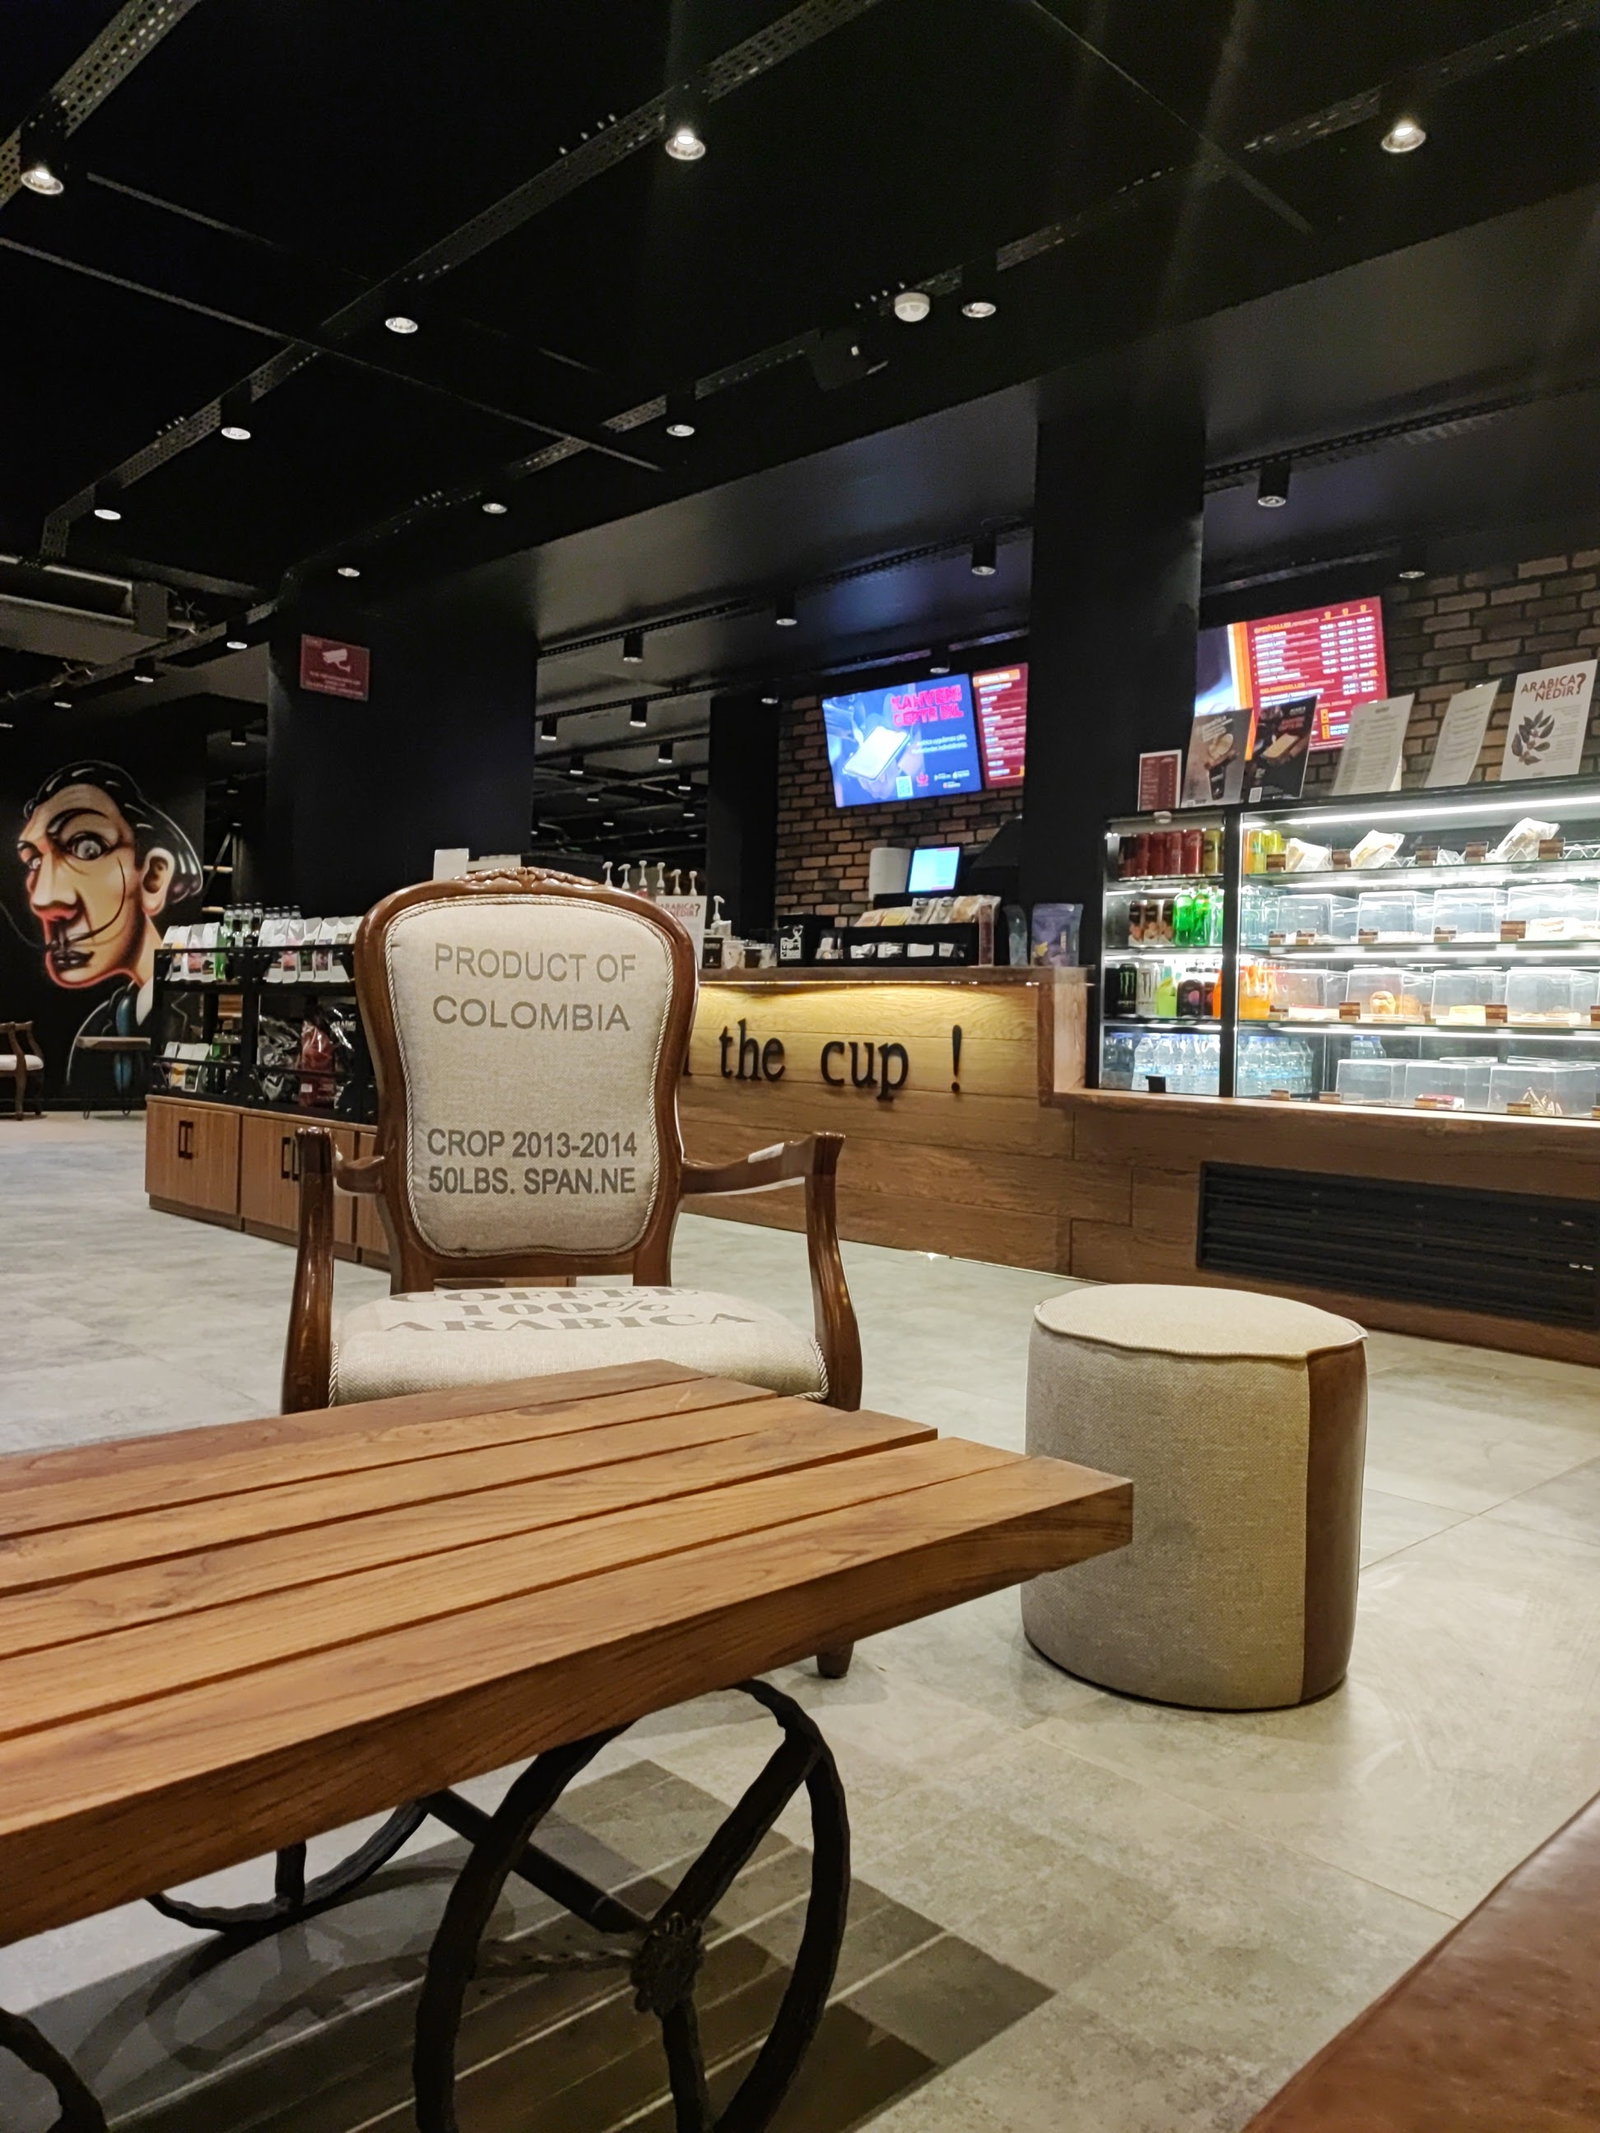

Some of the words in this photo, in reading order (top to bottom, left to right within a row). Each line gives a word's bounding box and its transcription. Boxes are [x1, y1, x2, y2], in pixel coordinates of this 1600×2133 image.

[1521, 674, 1576, 694] ARABICA
[435, 943, 587, 983] PRODUCT
[596, 953, 637, 983] OF
[433, 995, 630, 1032] COLOMBIA
[719, 1018, 786, 1081] the
[821, 1039, 909, 1101] cup
[427, 1128, 505, 1157] CROP
[512, 1130, 637, 1158] 2013-2014
[428, 1166, 514, 1195] 50LBS.
[523, 1167, 636, 1195] SPAN.NE
[390, 1288, 700, 1303] COFFEE
[459, 1299, 669, 1316] 100%
[384, 1312, 757, 1332] ARABICA
